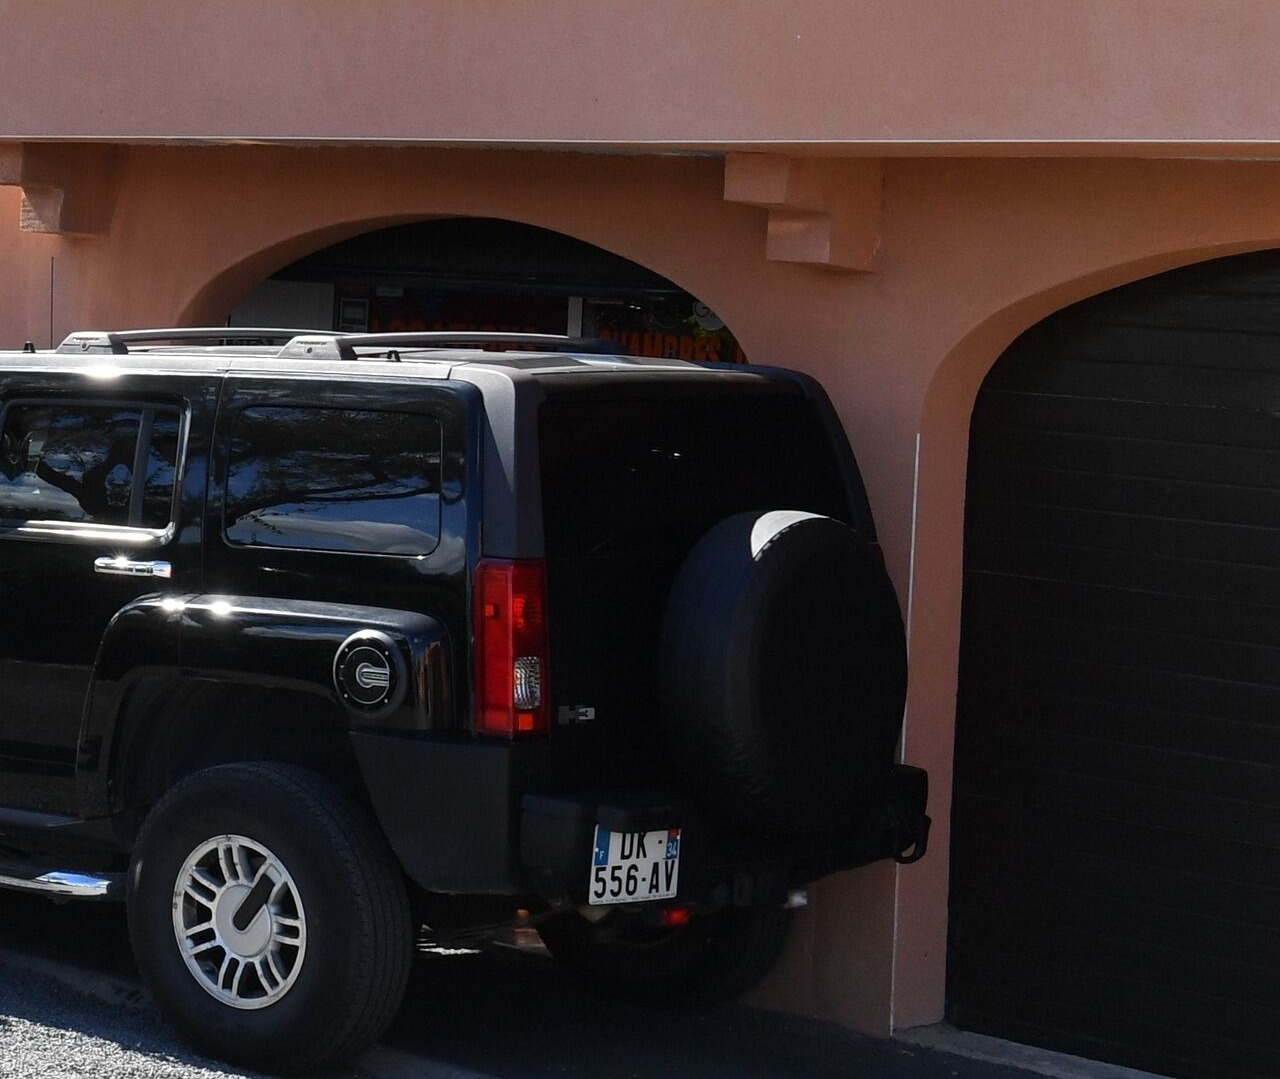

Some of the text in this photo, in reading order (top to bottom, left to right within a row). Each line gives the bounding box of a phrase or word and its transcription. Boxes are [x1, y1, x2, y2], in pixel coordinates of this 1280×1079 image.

[598, 850, 605, 861] F
[620, 831, 648, 861] DK
[666, 842, 678, 858] 34
[593, 859, 676, 899] 556-AV
